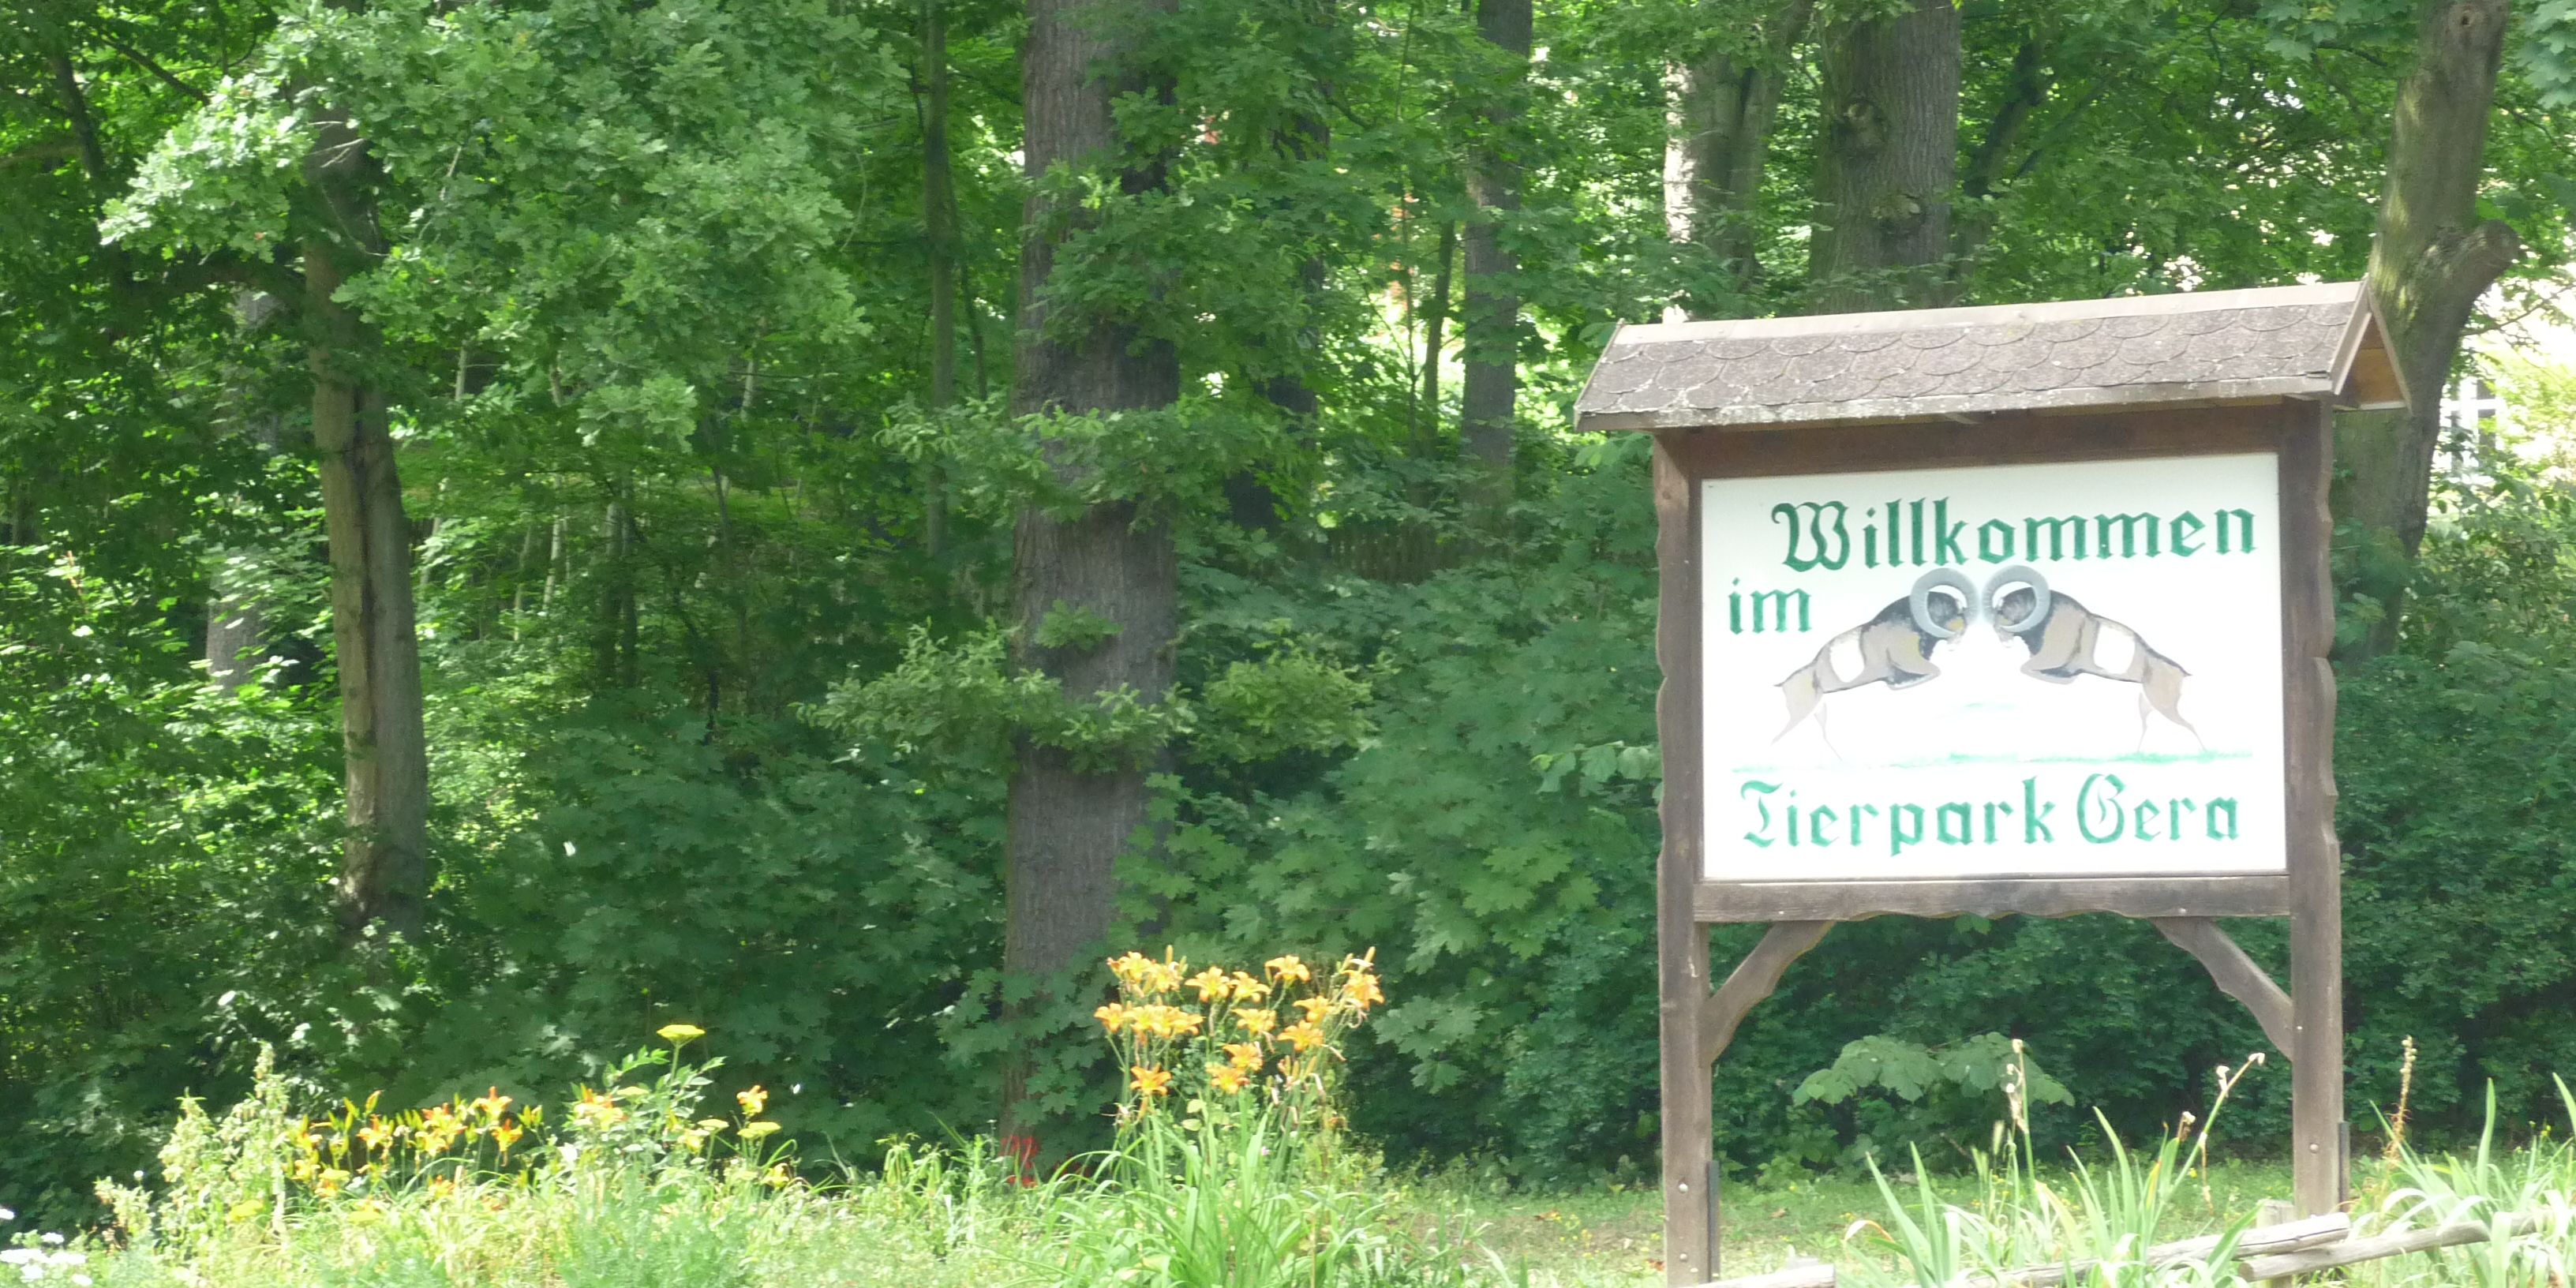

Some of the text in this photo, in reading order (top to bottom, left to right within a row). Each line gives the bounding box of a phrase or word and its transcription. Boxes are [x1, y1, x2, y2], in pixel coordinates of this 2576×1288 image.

[1771, 496, 2257, 573] Willkommen
[1728, 578, 1813, 635] im
[1740, 773, 2240, 857] Tierpark Gera
